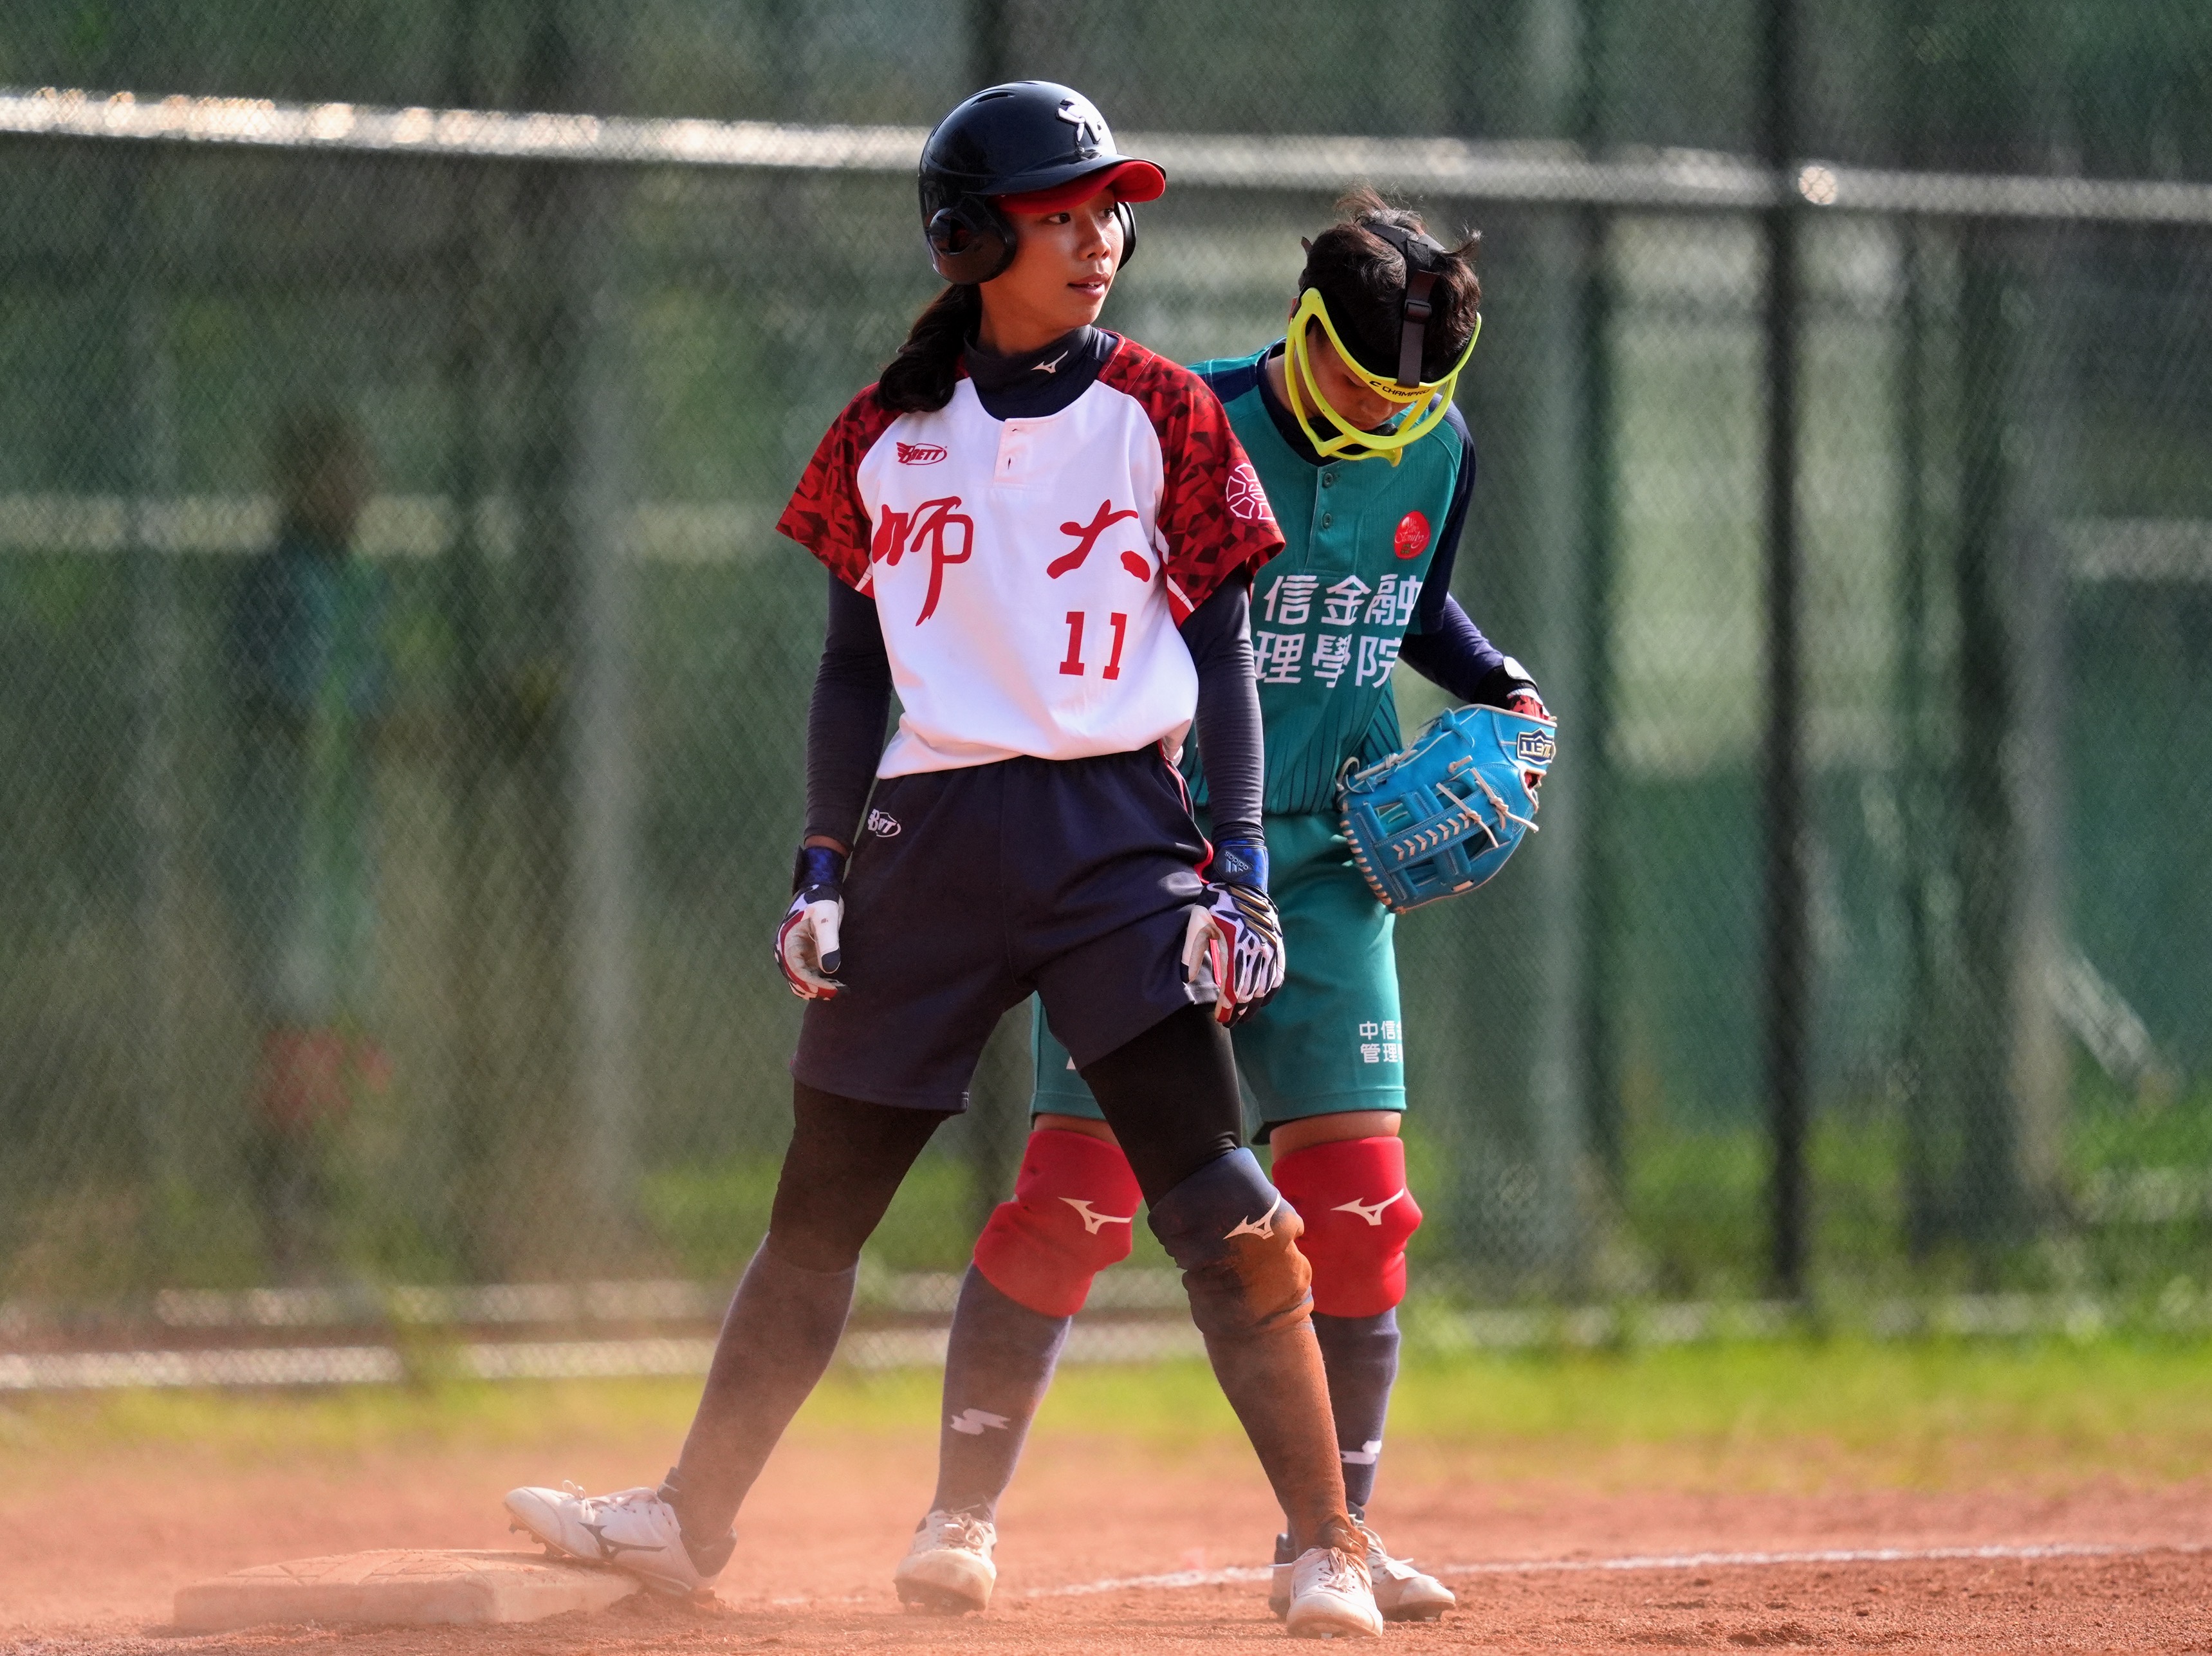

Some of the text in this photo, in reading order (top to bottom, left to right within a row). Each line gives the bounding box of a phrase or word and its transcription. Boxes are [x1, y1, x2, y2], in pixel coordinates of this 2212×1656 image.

[1382, 386, 1431, 397] CHAMPRO
[1248, 574, 1423, 626] 信金融
[1059, 611, 1127, 680] 11
[1224, 851, 1249, 870] adidas
[1360, 1043, 1403, 1063] 管理
